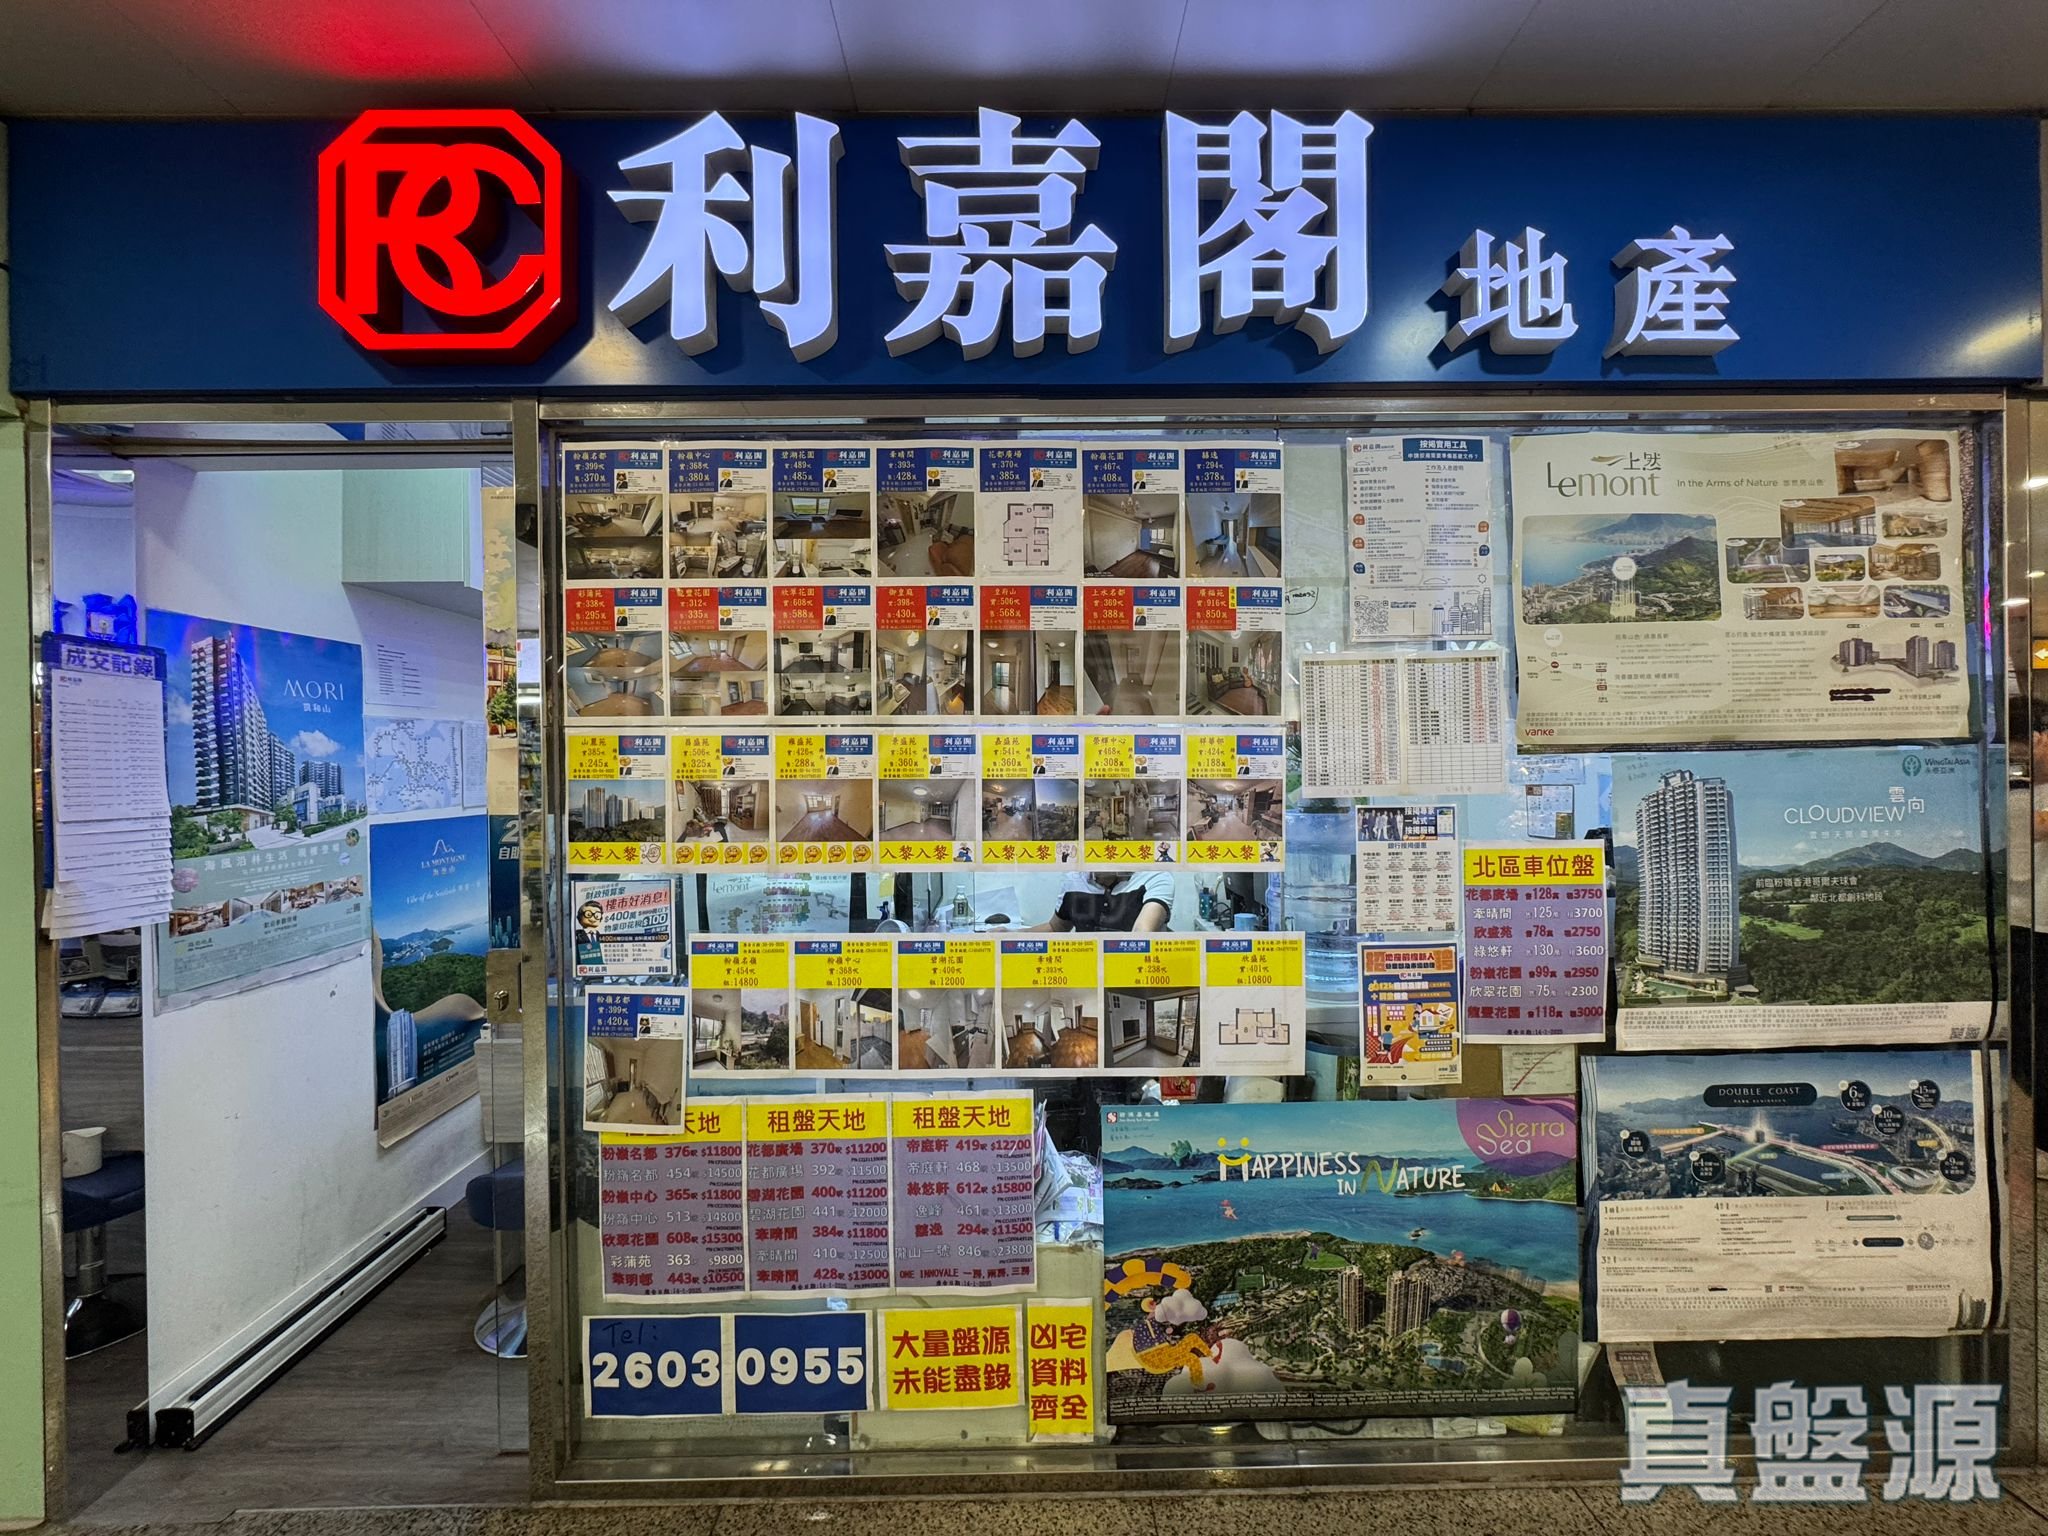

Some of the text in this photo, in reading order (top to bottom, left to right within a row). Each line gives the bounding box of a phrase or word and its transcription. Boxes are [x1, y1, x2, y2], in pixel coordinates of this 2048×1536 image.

[606, 107, 1741, 350] 利嘉閣 地產
[1547, 461, 1661, 498] Lemont
[1677, 479, 1685, 487] In
[1688, 479, 1703, 487] the
[1706, 479, 1732, 487] Arms
[1734, 479, 1745, 487] of
[1747, 479, 1778, 487] Nature
[66, 649, 153, 677] 成交記錄
[284, 679, 345, 701] MORI
[1524, 727, 1555, 737] vanke
[1784, 805, 1905, 824] CLOUDVIEW
[1473, 855, 1594, 878] 北區車位盤
[1466, 888, 1518, 900] 花都廣場
[1470, 985, 1521, 997] 欣翠花園
[1718, 1087, 1800, 1096] DOUBLE COAST
[768, 1109, 865, 1132] 租盤天地
[913, 1105, 1011, 1129] 租盤天地
[1477, 1110, 1565, 1138] Sierra
[701, 1145, 741, 1157] $11800
[748, 1143, 803, 1157] 花都廣場
[846, 1143, 887, 1154] $11200
[907, 1140, 948, 1152] 帝庭軒
[1478, 1139, 1531, 1156] Sea
[908, 1162, 948, 1174] 帝庭軒
[1217, 1141, 1361, 1182] HAPPINESS
[749, 1166, 803, 1179] 花都廣場
[1337, 1159, 1465, 1195] IN NATURE
[847, 1187, 887, 1198] $11200
[992, 1183, 1031, 1193] $15800
[701, 1190, 741, 1200] $11800
[848, 1228, 887, 1238] $11800
[992, 1224, 1032, 1235] $11500
[701, 1233, 742, 1243] $15300
[610, 1255, 651, 1268] 彩蒲苑
[702, 1272, 744, 1284] $10500
[848, 1269, 889, 1280] $13000
[900, 1270, 914, 1278] ONE
[892, 1326, 1010, 1359] 大量盤源
[1030, 1323, 1087, 1349] 凶宅
[592, 1347, 864, 1388] 2603 0955
[1031, 1358, 1087, 1386] 資料
[894, 1363, 1011, 1394] 未能盡錄
[1031, 1395, 1088, 1420] 齊全
